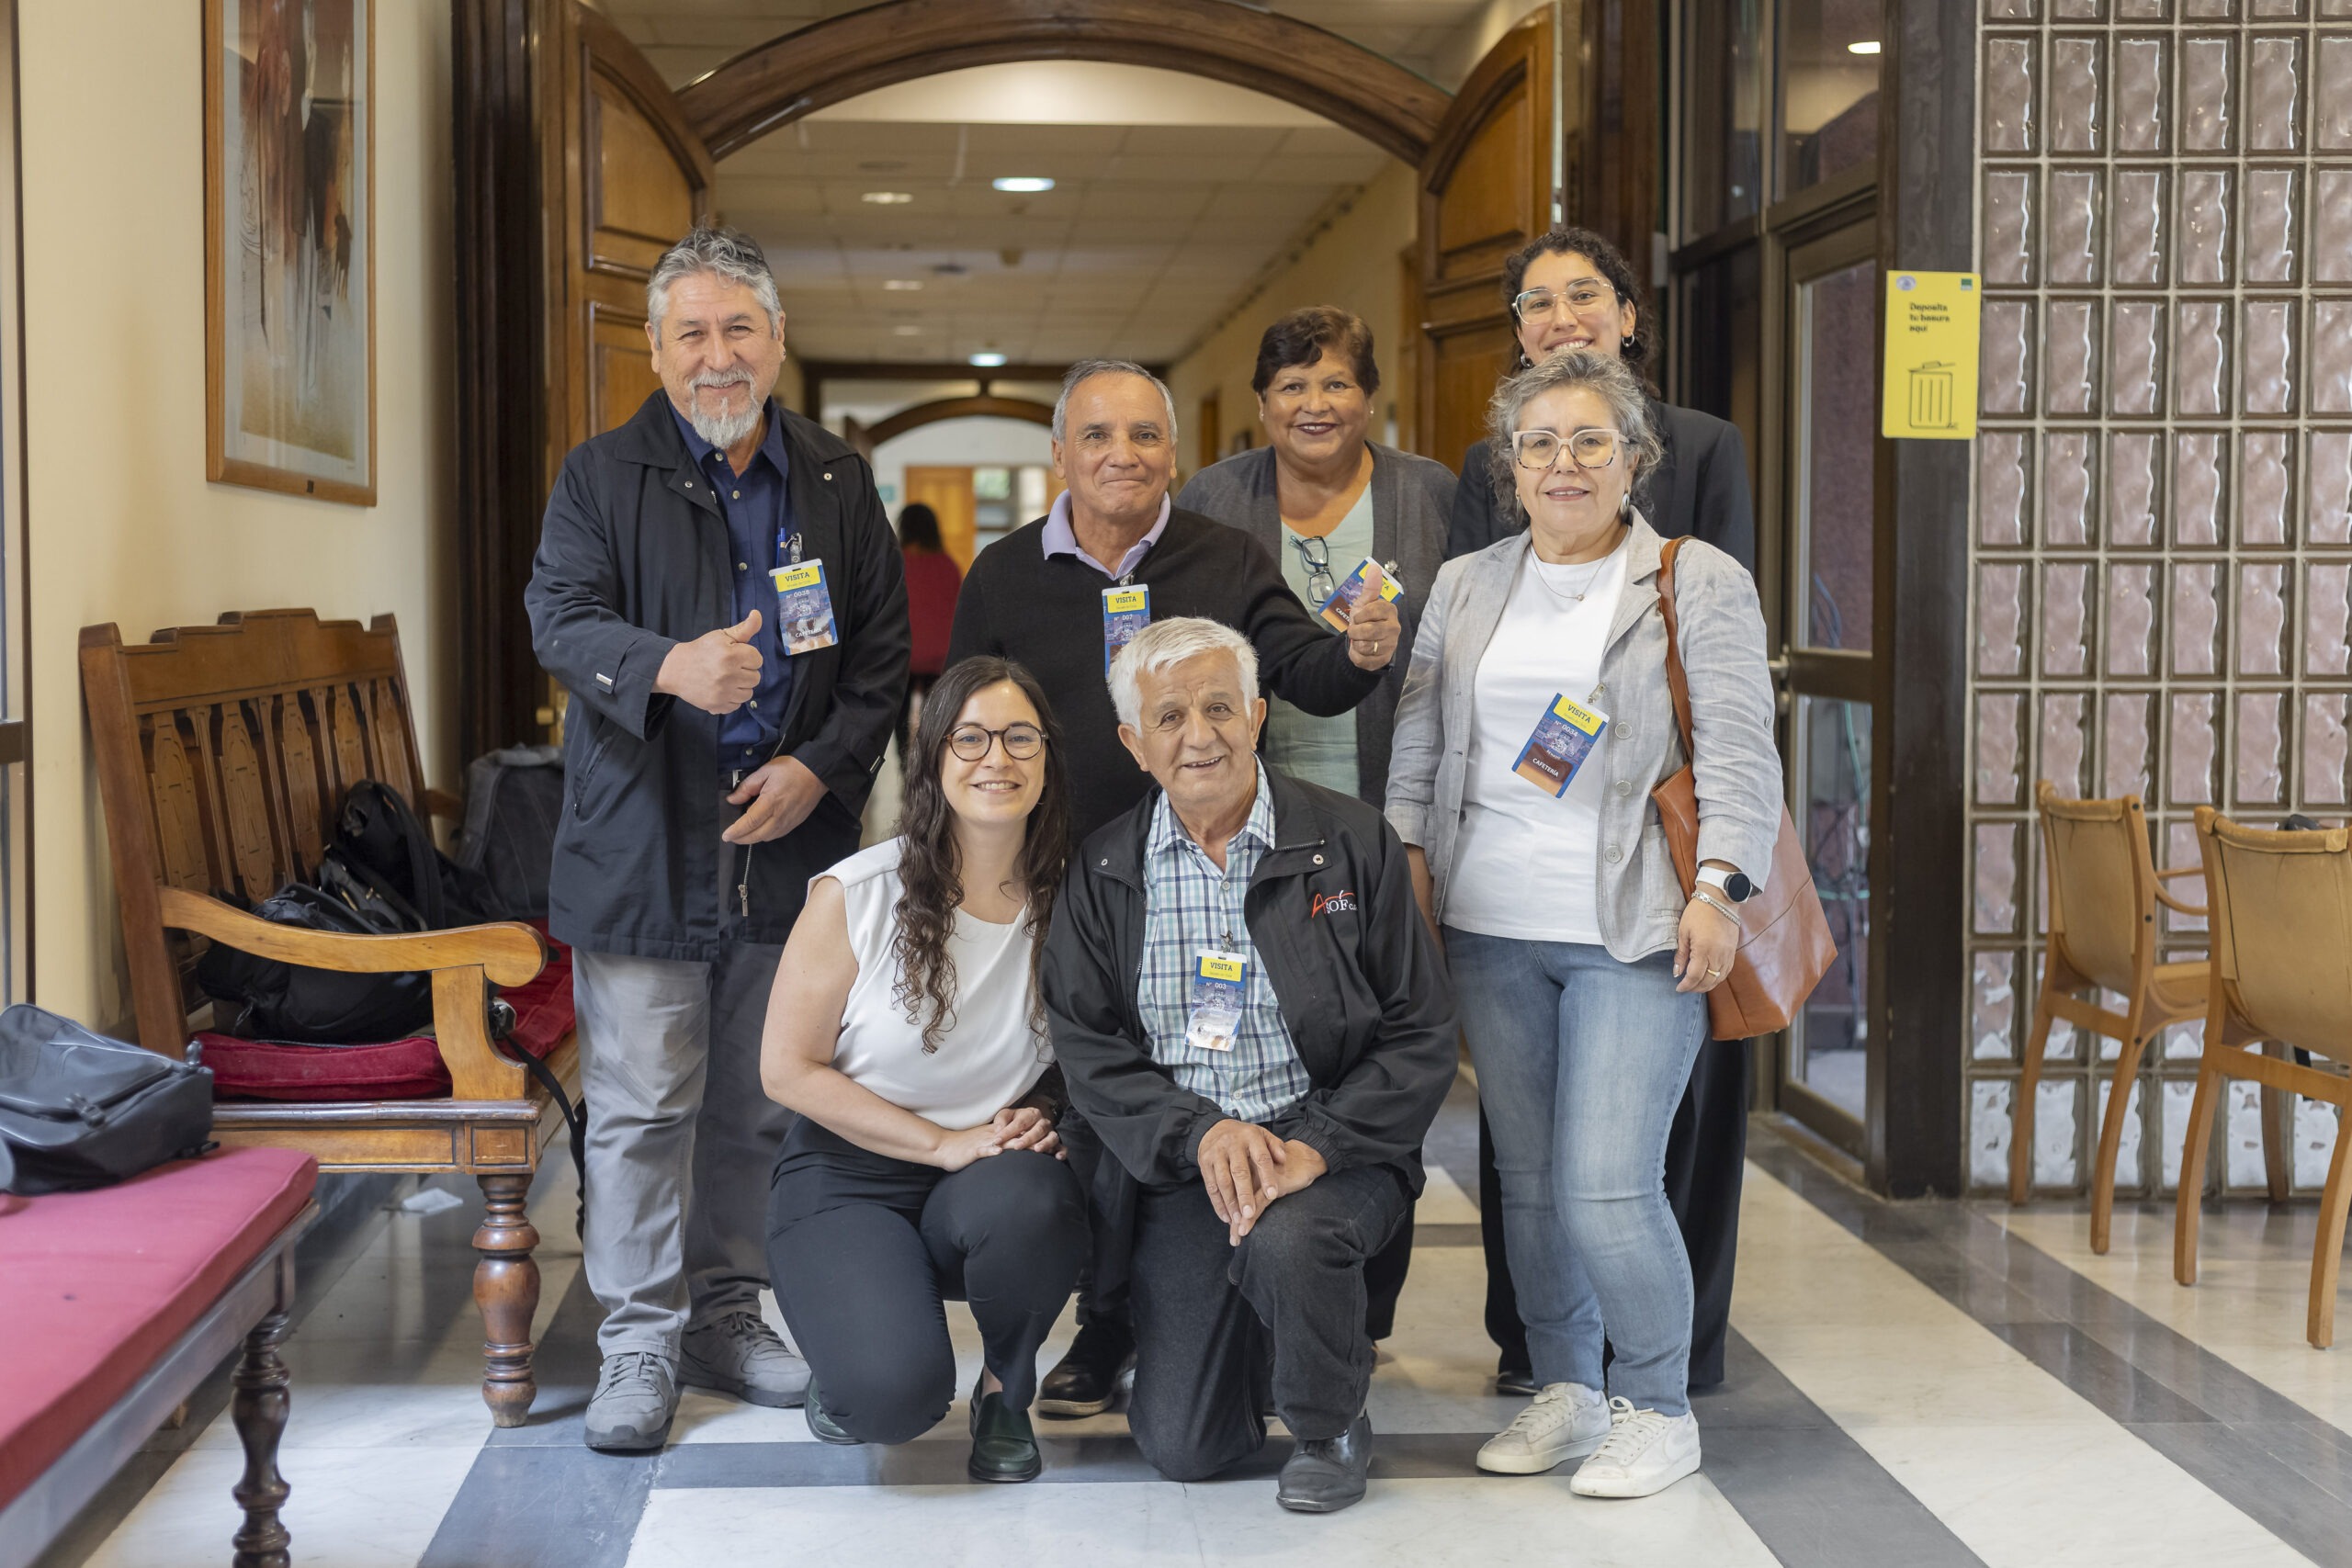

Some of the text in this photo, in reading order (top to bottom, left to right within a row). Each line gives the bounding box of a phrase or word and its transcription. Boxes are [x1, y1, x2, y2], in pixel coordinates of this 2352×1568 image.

[1909, 302, 1948, 312] Deposita
[1909, 313, 1950, 321] tu basura
[785, 571, 810, 582] VISITA
[1115, 595, 1136, 604] VISITA
[1567, 704, 1591, 723] VISITA
[1210, 962, 1233, 971] VISITA
